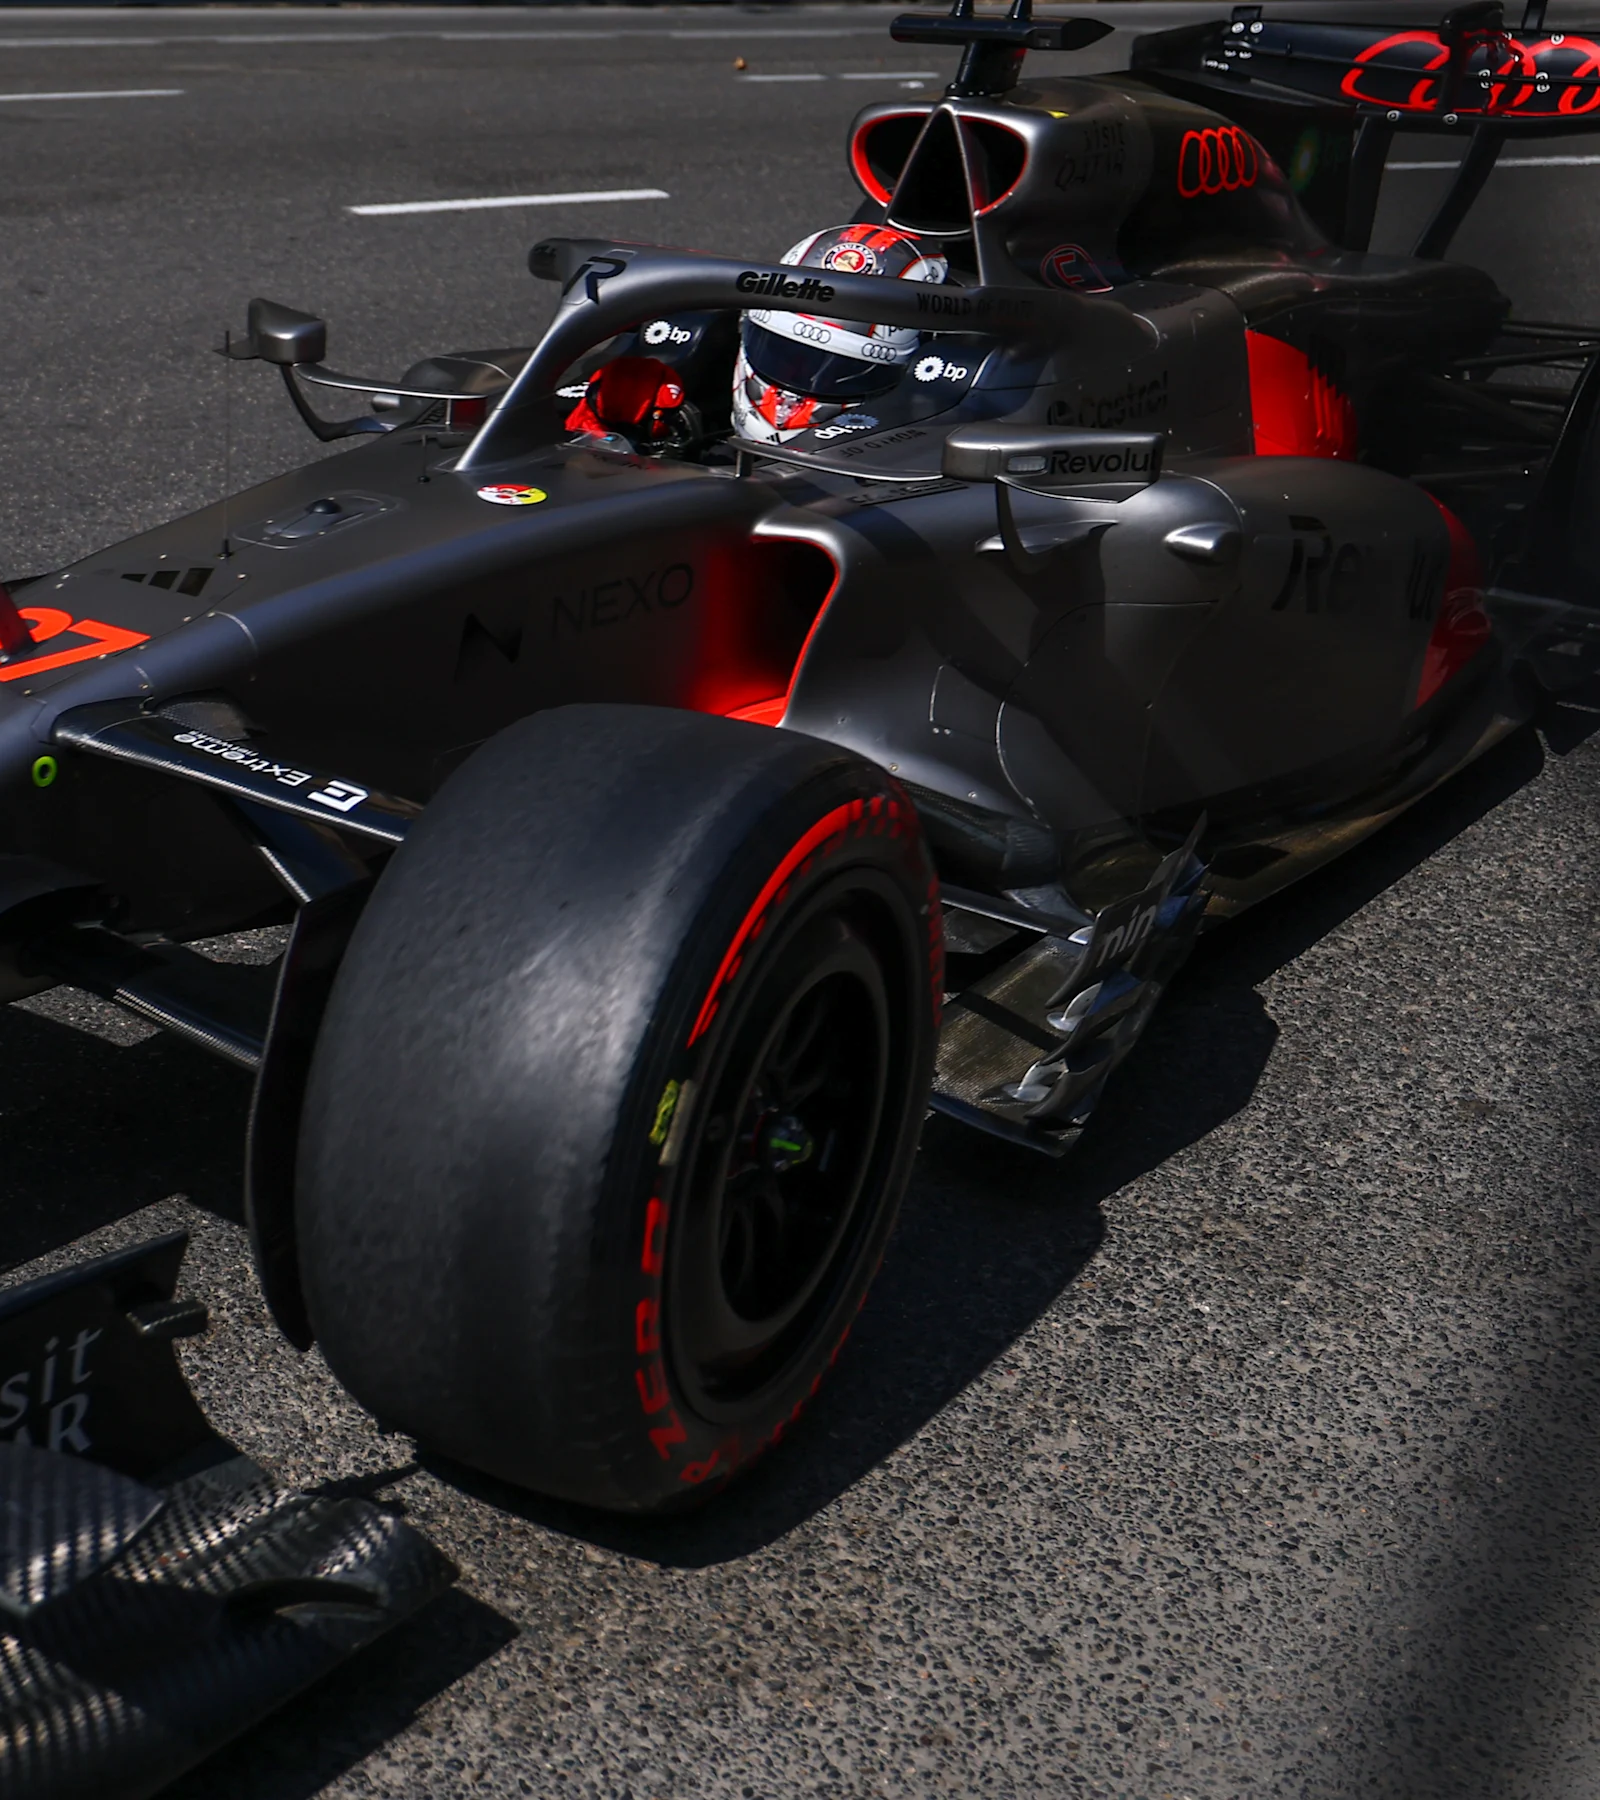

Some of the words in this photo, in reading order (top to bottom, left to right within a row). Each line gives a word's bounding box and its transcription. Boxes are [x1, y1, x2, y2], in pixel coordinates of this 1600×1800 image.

[736, 271, 835, 302] Gillette
[917, 293, 971, 316] WORLD
[668, 325, 693, 345] bp
[942, 361, 969, 383] bp
[552, 563, 695, 638] NEXO
[173, 733, 312, 787] Extreme
